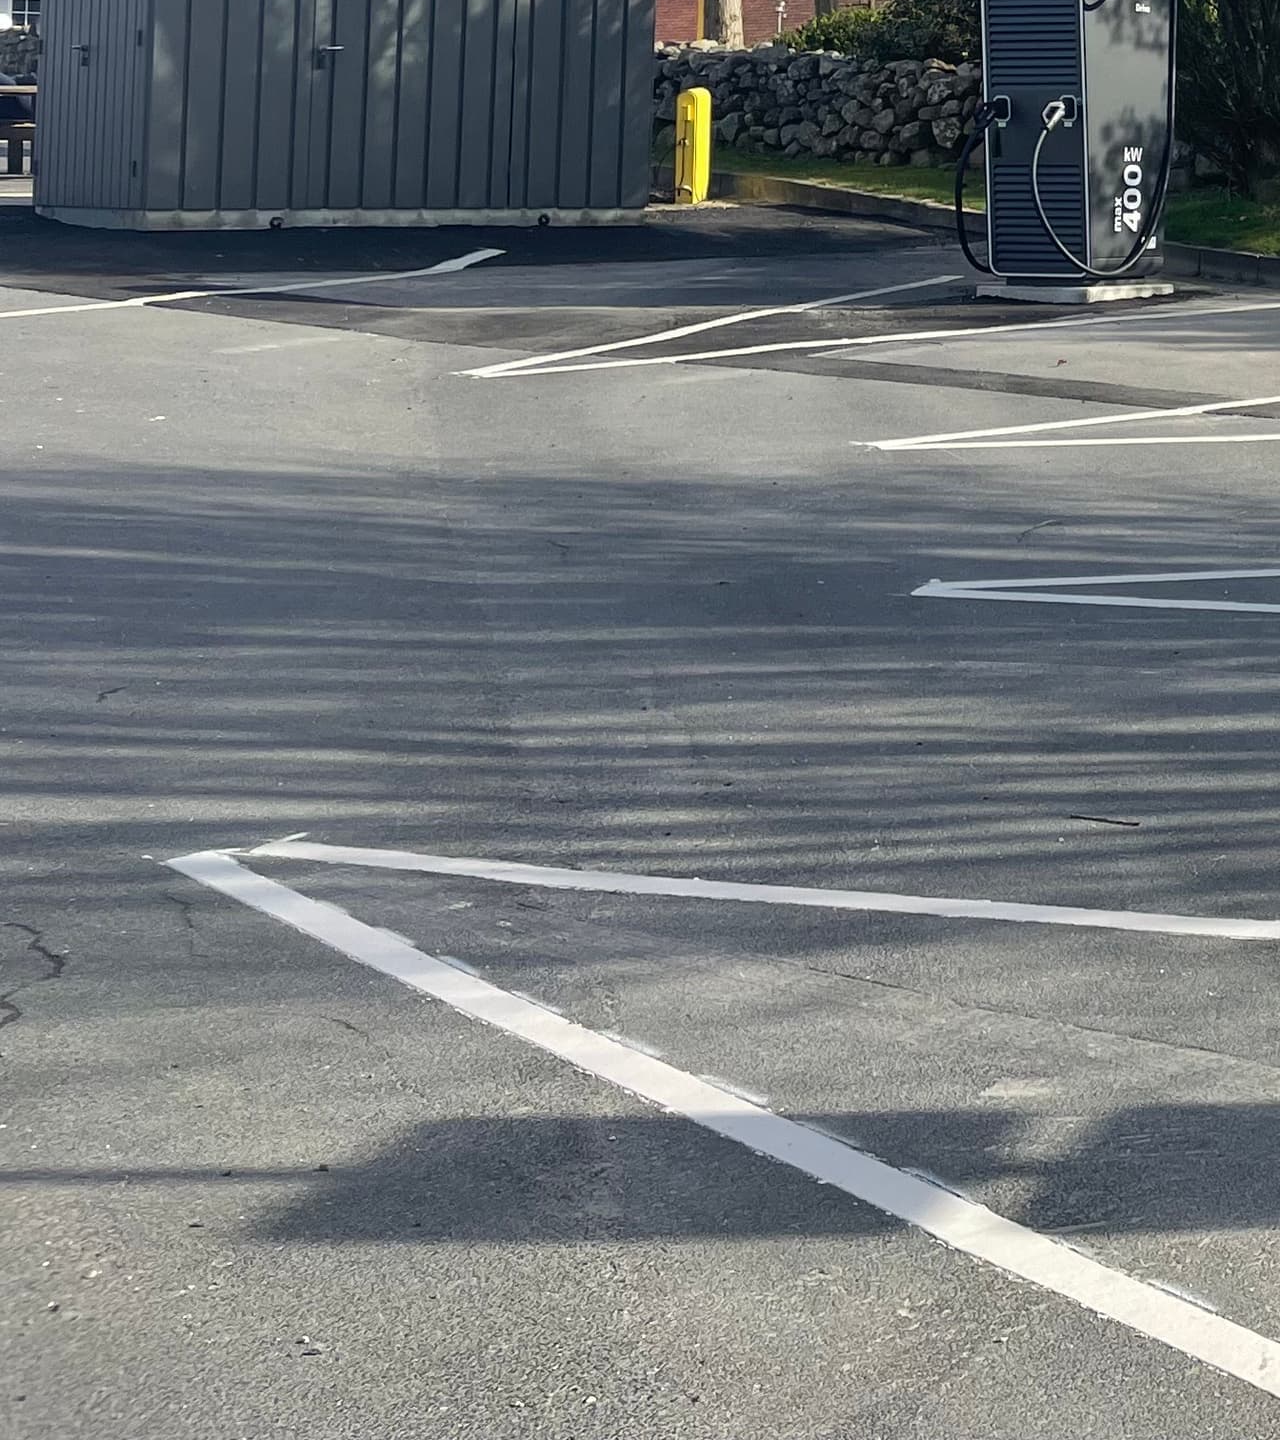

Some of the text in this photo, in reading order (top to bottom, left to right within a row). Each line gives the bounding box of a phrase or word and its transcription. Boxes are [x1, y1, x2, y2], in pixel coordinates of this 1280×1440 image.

[1114, 196, 1123, 232] max
[1123, 146, 1143, 233] 400 kW
